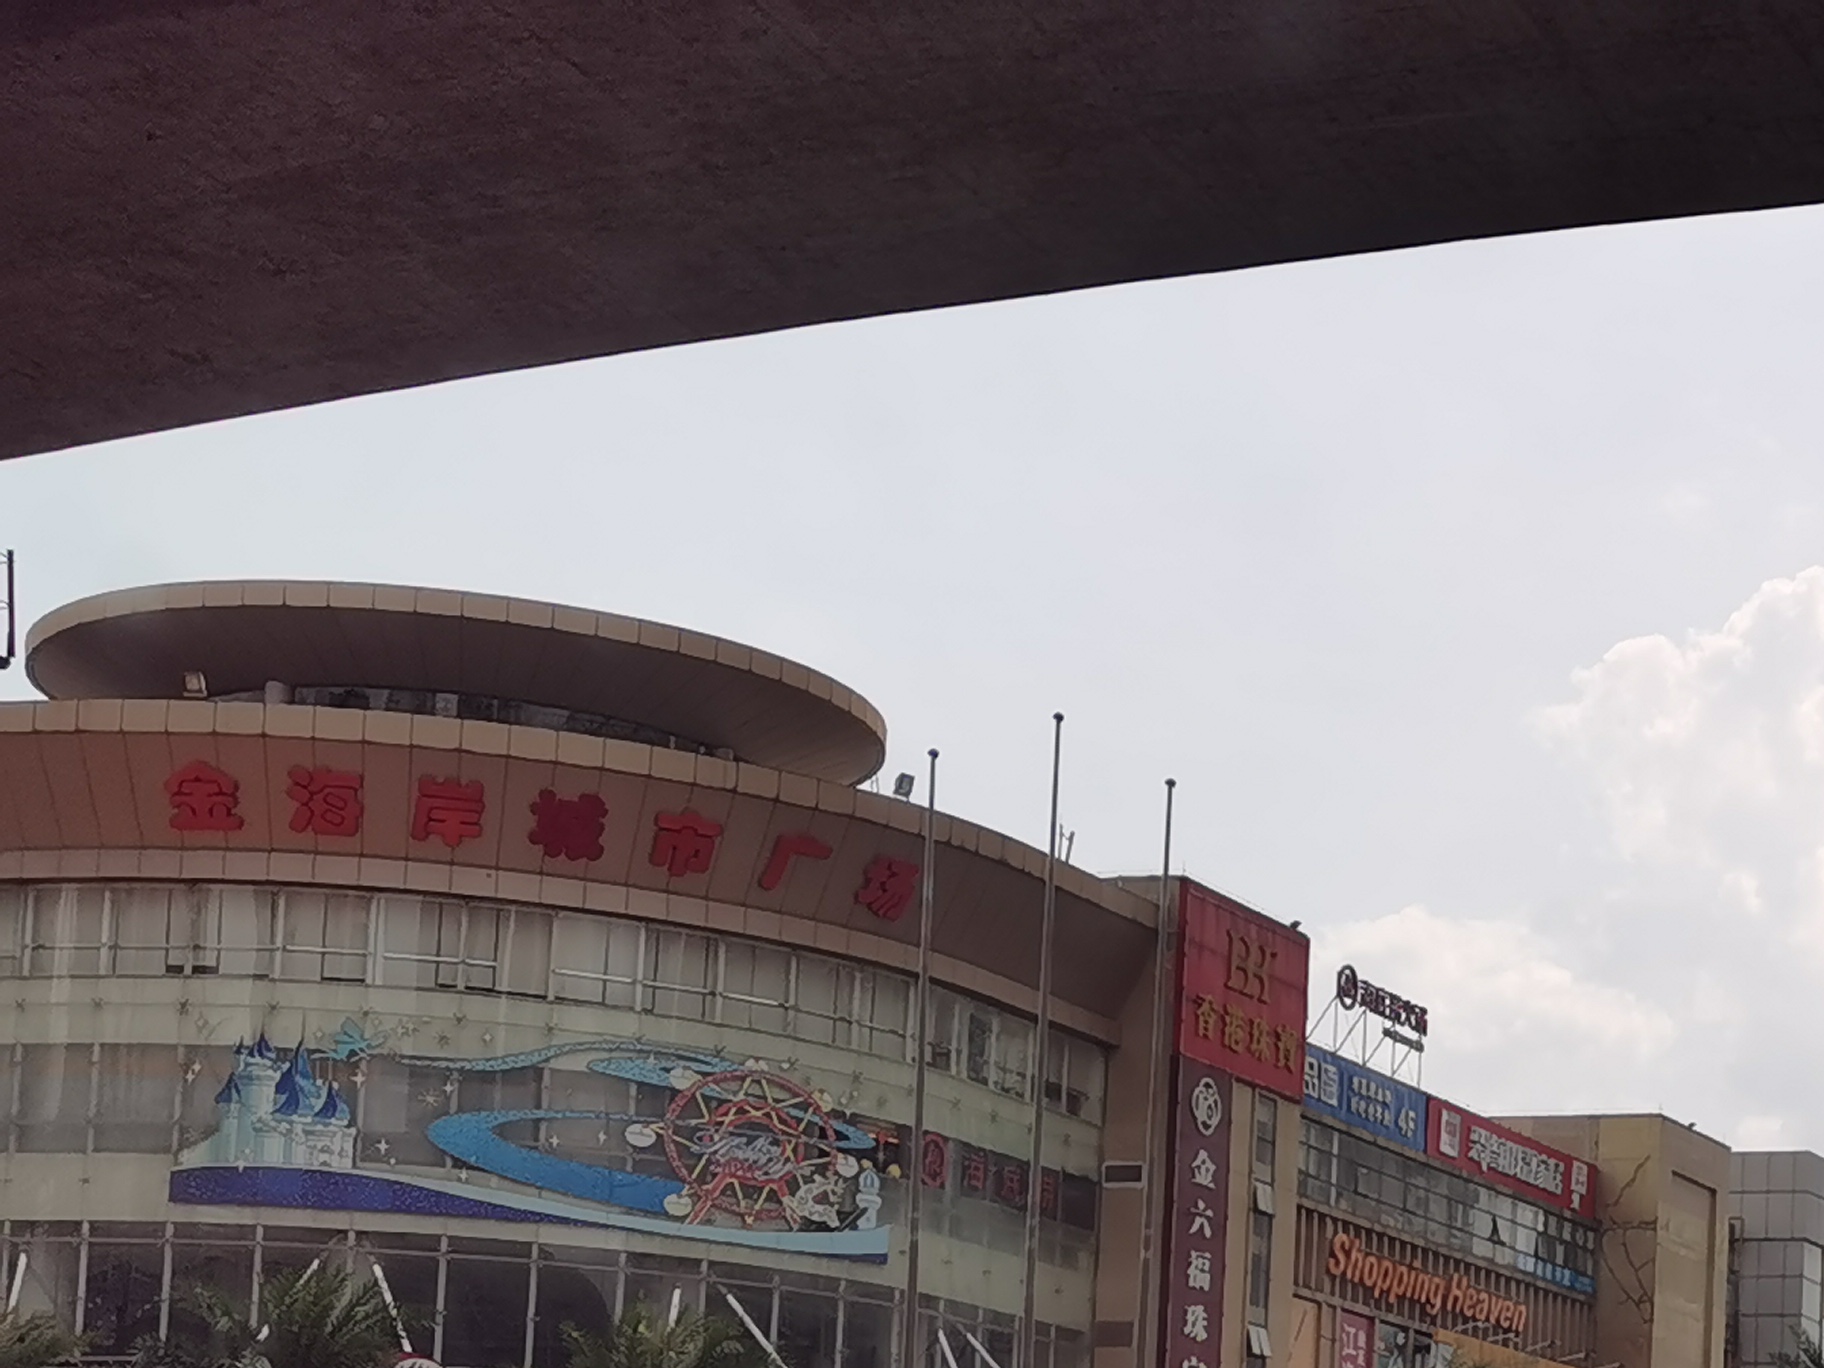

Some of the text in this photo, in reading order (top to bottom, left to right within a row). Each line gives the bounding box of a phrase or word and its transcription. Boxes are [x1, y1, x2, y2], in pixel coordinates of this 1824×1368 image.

[164, 758, 920, 922] 金海岸城市广场
[1326, 1232, 1445, 1317] Shopping
[1446, 1272, 1528, 1332] Heaven
